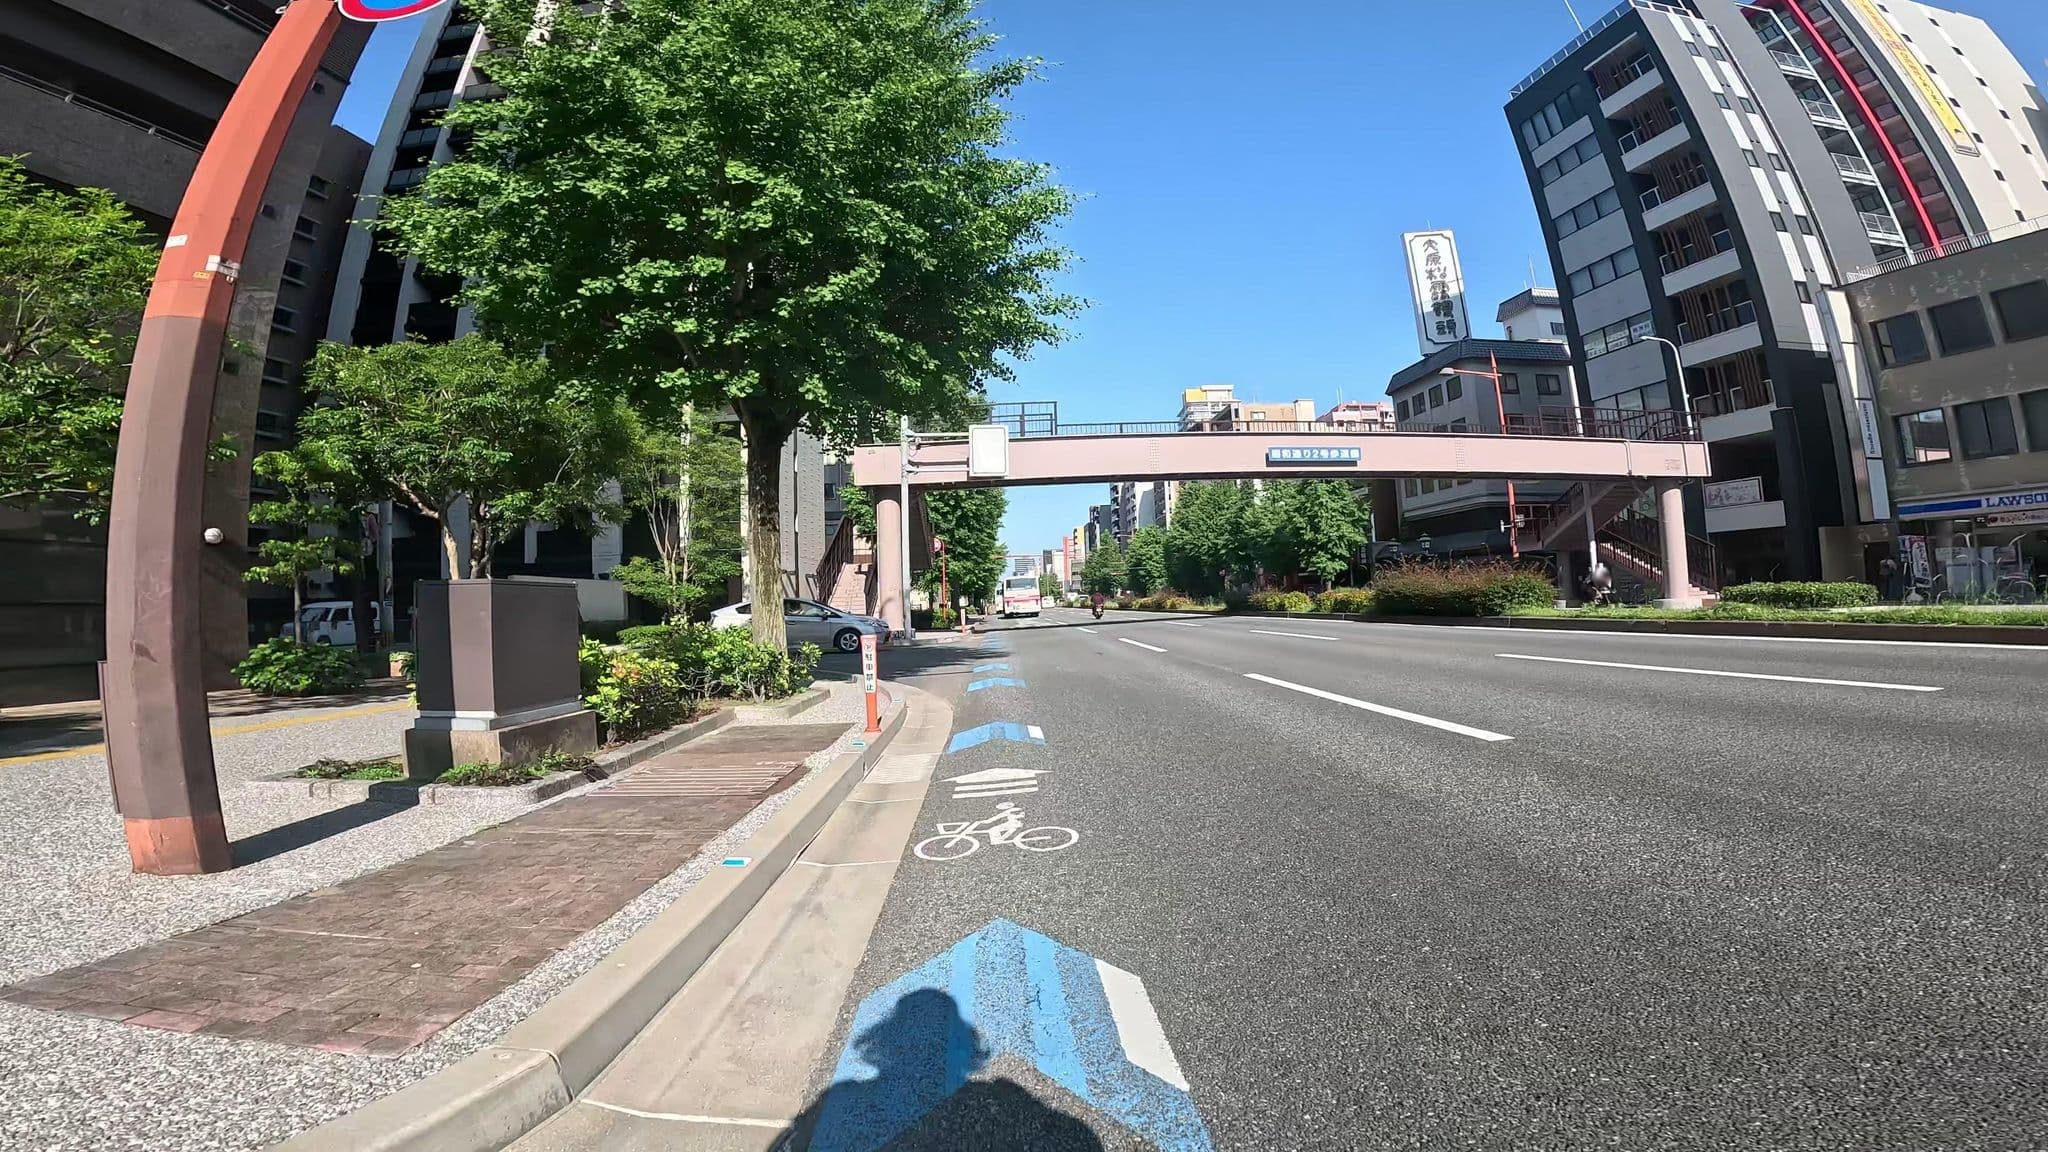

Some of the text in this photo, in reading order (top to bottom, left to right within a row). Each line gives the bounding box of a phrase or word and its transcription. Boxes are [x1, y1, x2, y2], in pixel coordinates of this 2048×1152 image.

[1422, 238, 1457, 339] 大原松露饅頭
[1985, 492, 2048, 508] LAWSO
